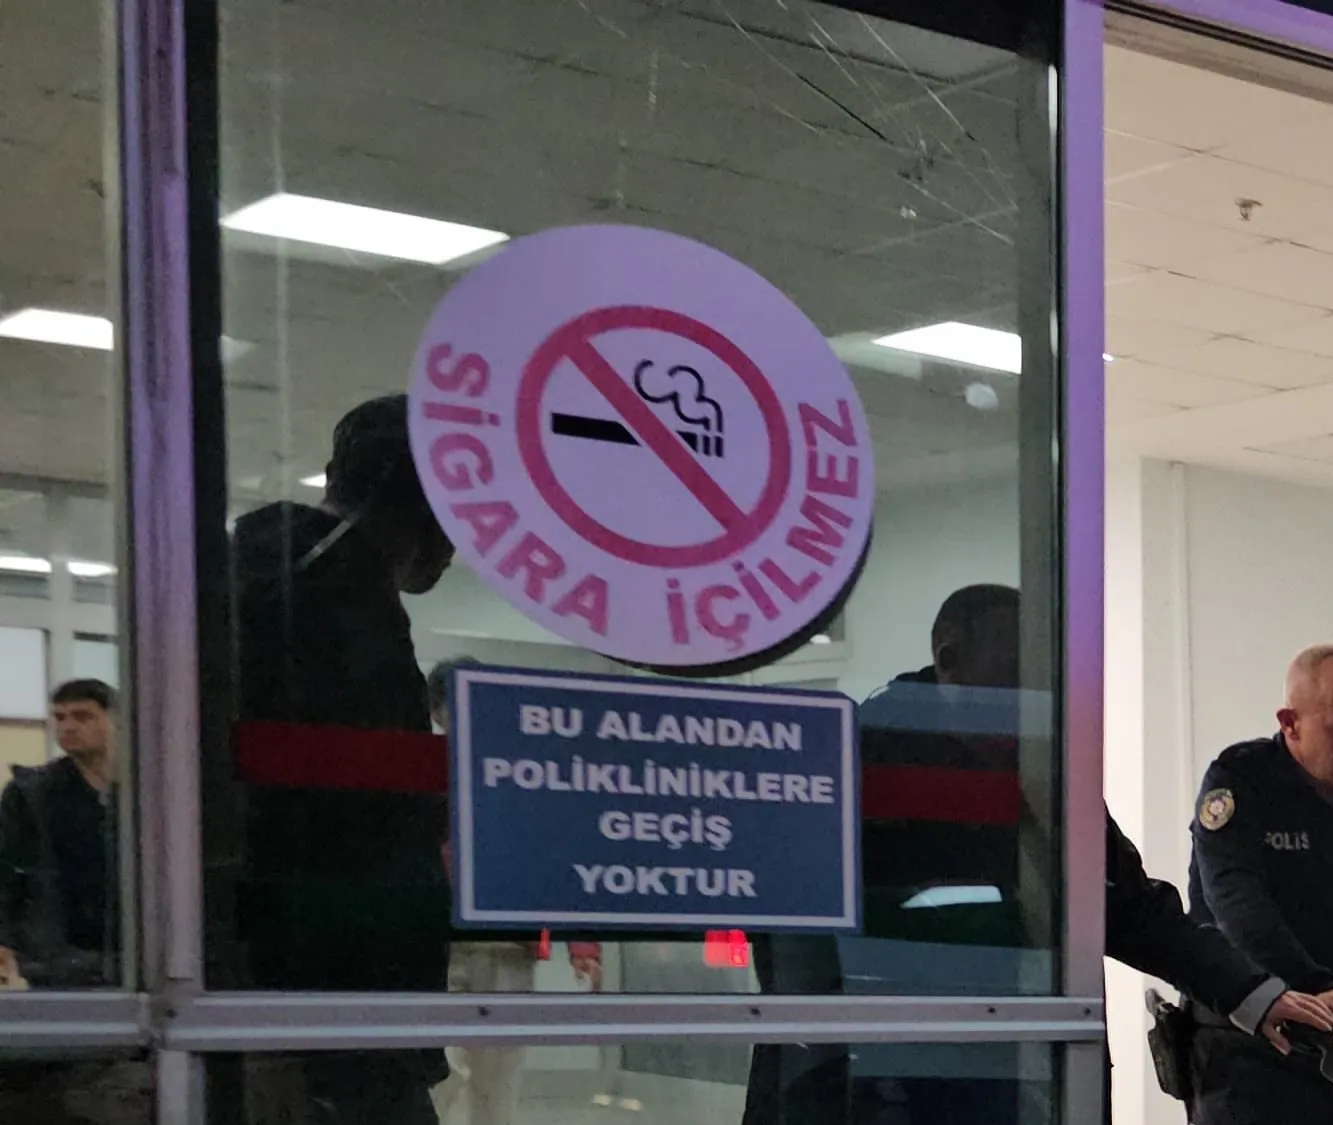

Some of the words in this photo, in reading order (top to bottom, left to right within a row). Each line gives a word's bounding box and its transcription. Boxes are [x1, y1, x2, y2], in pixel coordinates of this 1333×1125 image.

[422, 342, 609, 637] SİGARA
[664, 398, 860, 652] İÇİLMEZ
[519, 705, 583, 737] BU
[597, 711, 801, 750] ALANDAN
[483, 755, 835, 804] POLİKLİNİKLERE
[599, 808, 733, 850] GEÇİŞ
[574, 864, 757, 897] YOKTUR
